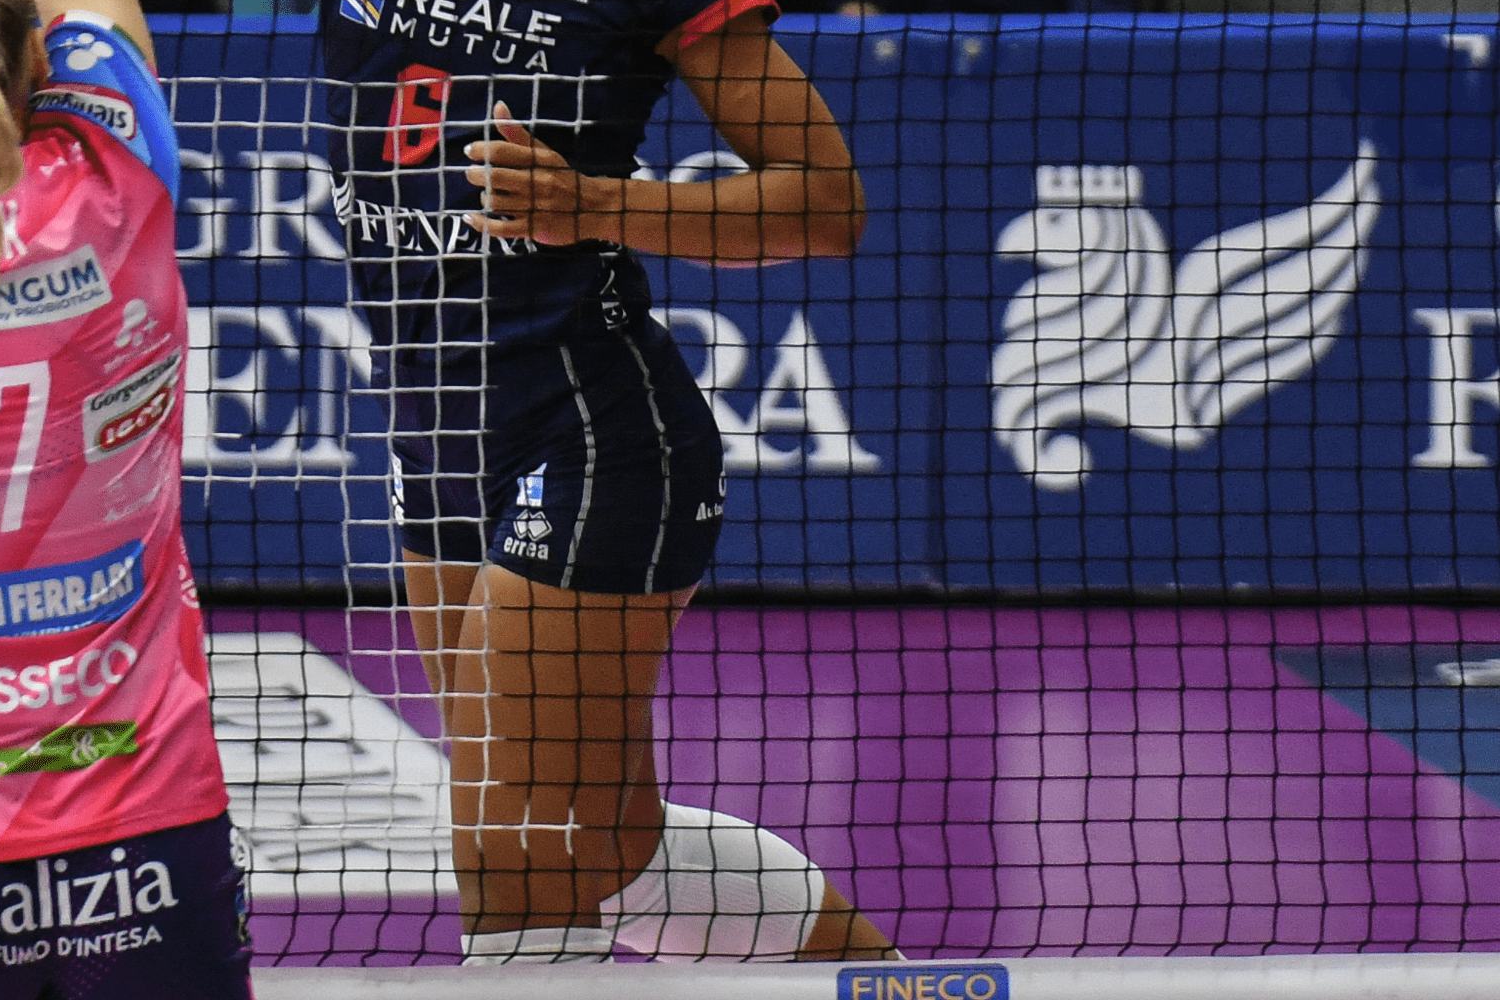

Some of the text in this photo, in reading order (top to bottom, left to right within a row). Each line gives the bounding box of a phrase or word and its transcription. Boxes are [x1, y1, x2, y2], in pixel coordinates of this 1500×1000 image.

[390, 12, 549, 72] MUTUA
[382, 62, 453, 165] 6
[503, 537, 549, 560] errea
[57, 924, 163, 957] D'INTESA
[853, 973, 997, 1000] FINECO
